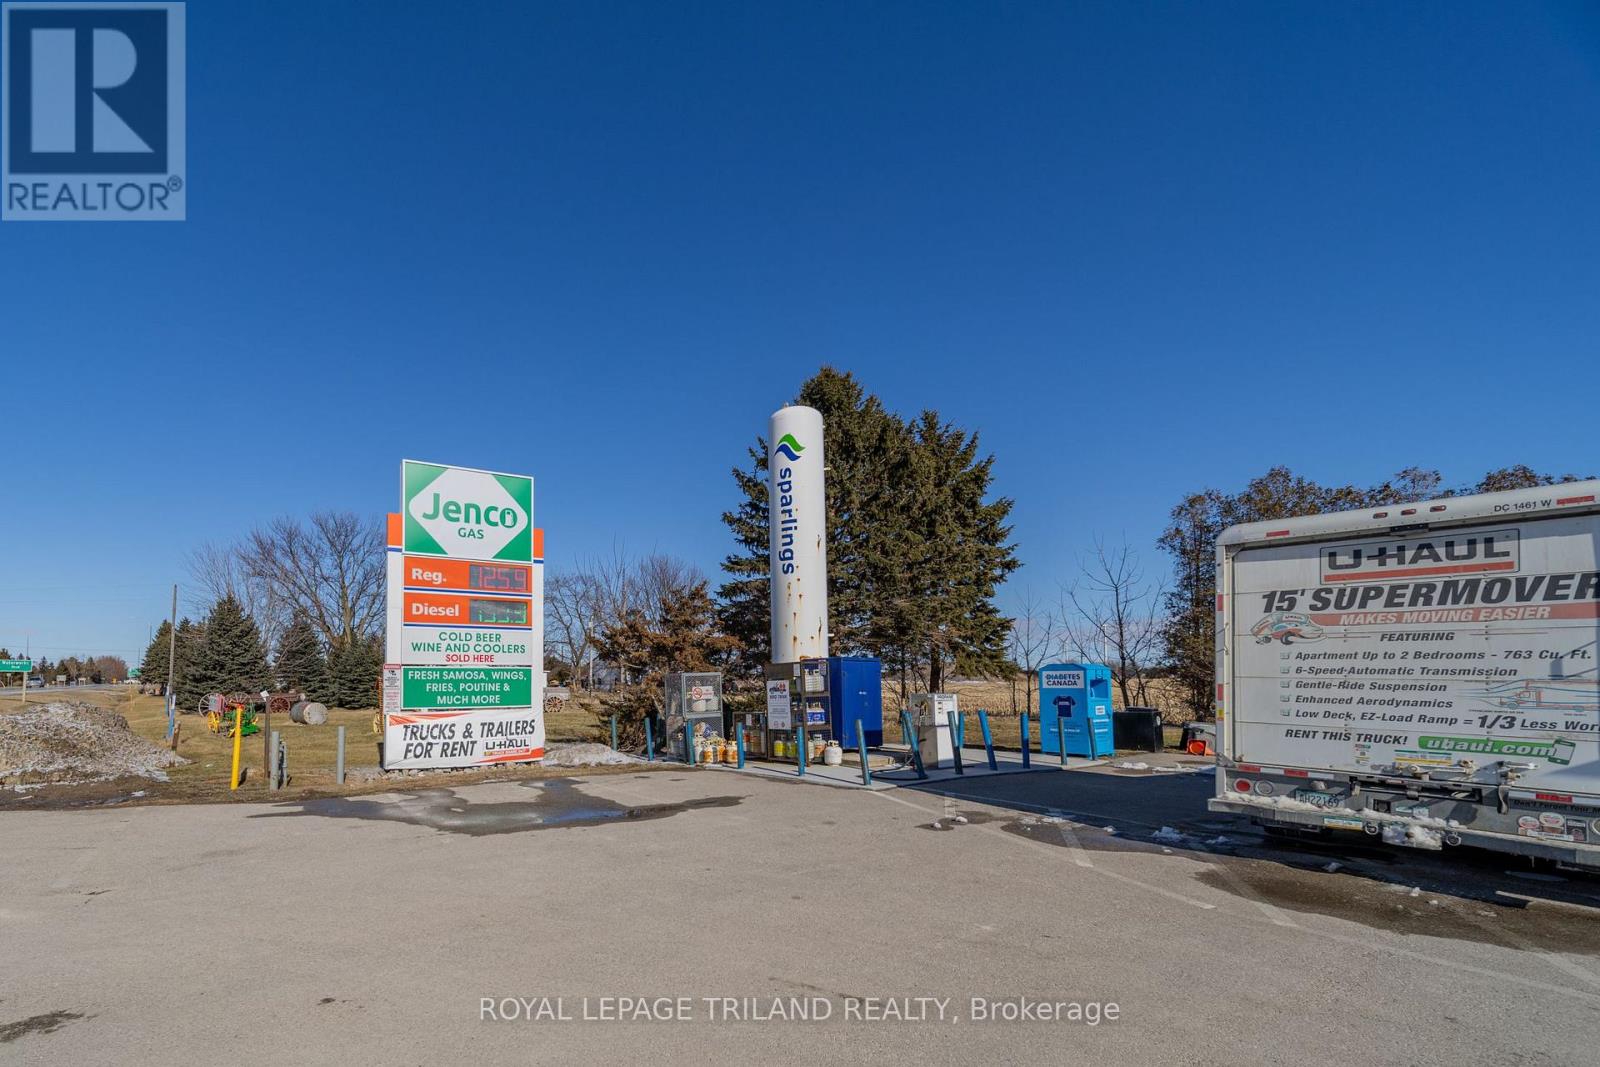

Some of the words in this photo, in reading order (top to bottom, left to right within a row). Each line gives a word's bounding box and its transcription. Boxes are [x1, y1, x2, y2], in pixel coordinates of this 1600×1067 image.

[422, 492, 518, 528] Jenco
[1494, 504, 1510, 512] DC
[1514, 501, 1537, 510] 1461
[1541, 499, 1552, 507] W
[777, 467, 798, 575] sparlings
[458, 528, 484, 539] GAS
[1328, 537, 1510, 570] U-HAUL
[411, 568, 447, 584] Reg.
[1309, 572, 1600, 612] SUPERMOVER
[412, 603, 460, 616] Diesel
[1339, 612, 1396, 625] MAKES
[1402, 609, 1473, 624] MOVING
[1478, 606, 1551, 621] EASIER
[439, 632, 472, 642] COLD
[476, 633, 501, 642] BEER
[1380, 632, 1455, 642] FEATURING
[411, 642, 442, 652] WINE
[445, 643, 470, 653] AND
[474, 644, 526, 654] COOLERS
[445, 654, 470, 663] SOLD
[473, 655, 494, 663] HERE
[1295, 651, 1358, 661] Apartment
[1362, 652, 1378, 661] Up
[1383, 652, 1395, 660] to
[1400, 651, 1409, 659] 2
[1413, 651, 1485, 660] Bedrooms
[1503, 650, 1533, 659] 763
[1539, 650, 1564, 659] Cu.
[1570, 649, 1591, 659] Ft.
[408, 671, 440, 680] FRESH
[443, 671, 489, 680] SAMOSA,
[491, 671, 527, 680] WINGS,
[1348, 667, 1415, 676] Automatic
[1420, 667, 1518, 676] Transmission
[426, 683, 456, 693] FRIES,
[460, 683, 500, 692] POUTINE
[503, 683, 510, 692] &
[1295, 681, 1365, 690] Gentle-Ride
[1369, 682, 1447, 692] Suspension
[437, 695, 469, 705] MUCH
[472, 695, 500, 704] MORE
[1295, 695, 1353, 705] Enhanced
[1356, 697, 1454, 708] Aerodynamics
[1295, 710, 1319, 718] Low
[1322, 710, 1356, 721] Deck,
[1360, 712, 1413, 723] EZ-Load
[1418, 714, 1458, 726] Ramp
[1478, 715, 1517, 729] 1/3
[1520, 719, 1557, 729] Less
[1564, 720, 1600, 731] Wor
[403, 722, 456, 741] TRUCKS
[463, 723, 473, 739] &
[480, 719, 535, 738] TRAILERS
[1285, 729, 1319, 739] RENT
[1322, 731, 1351, 742] THIS
[1356, 733, 1408, 745] TRUCK!
[403, 741, 433, 759] FOR
[440, 740, 477, 758] RENT
[485, 739, 529, 750] U-HAUL
